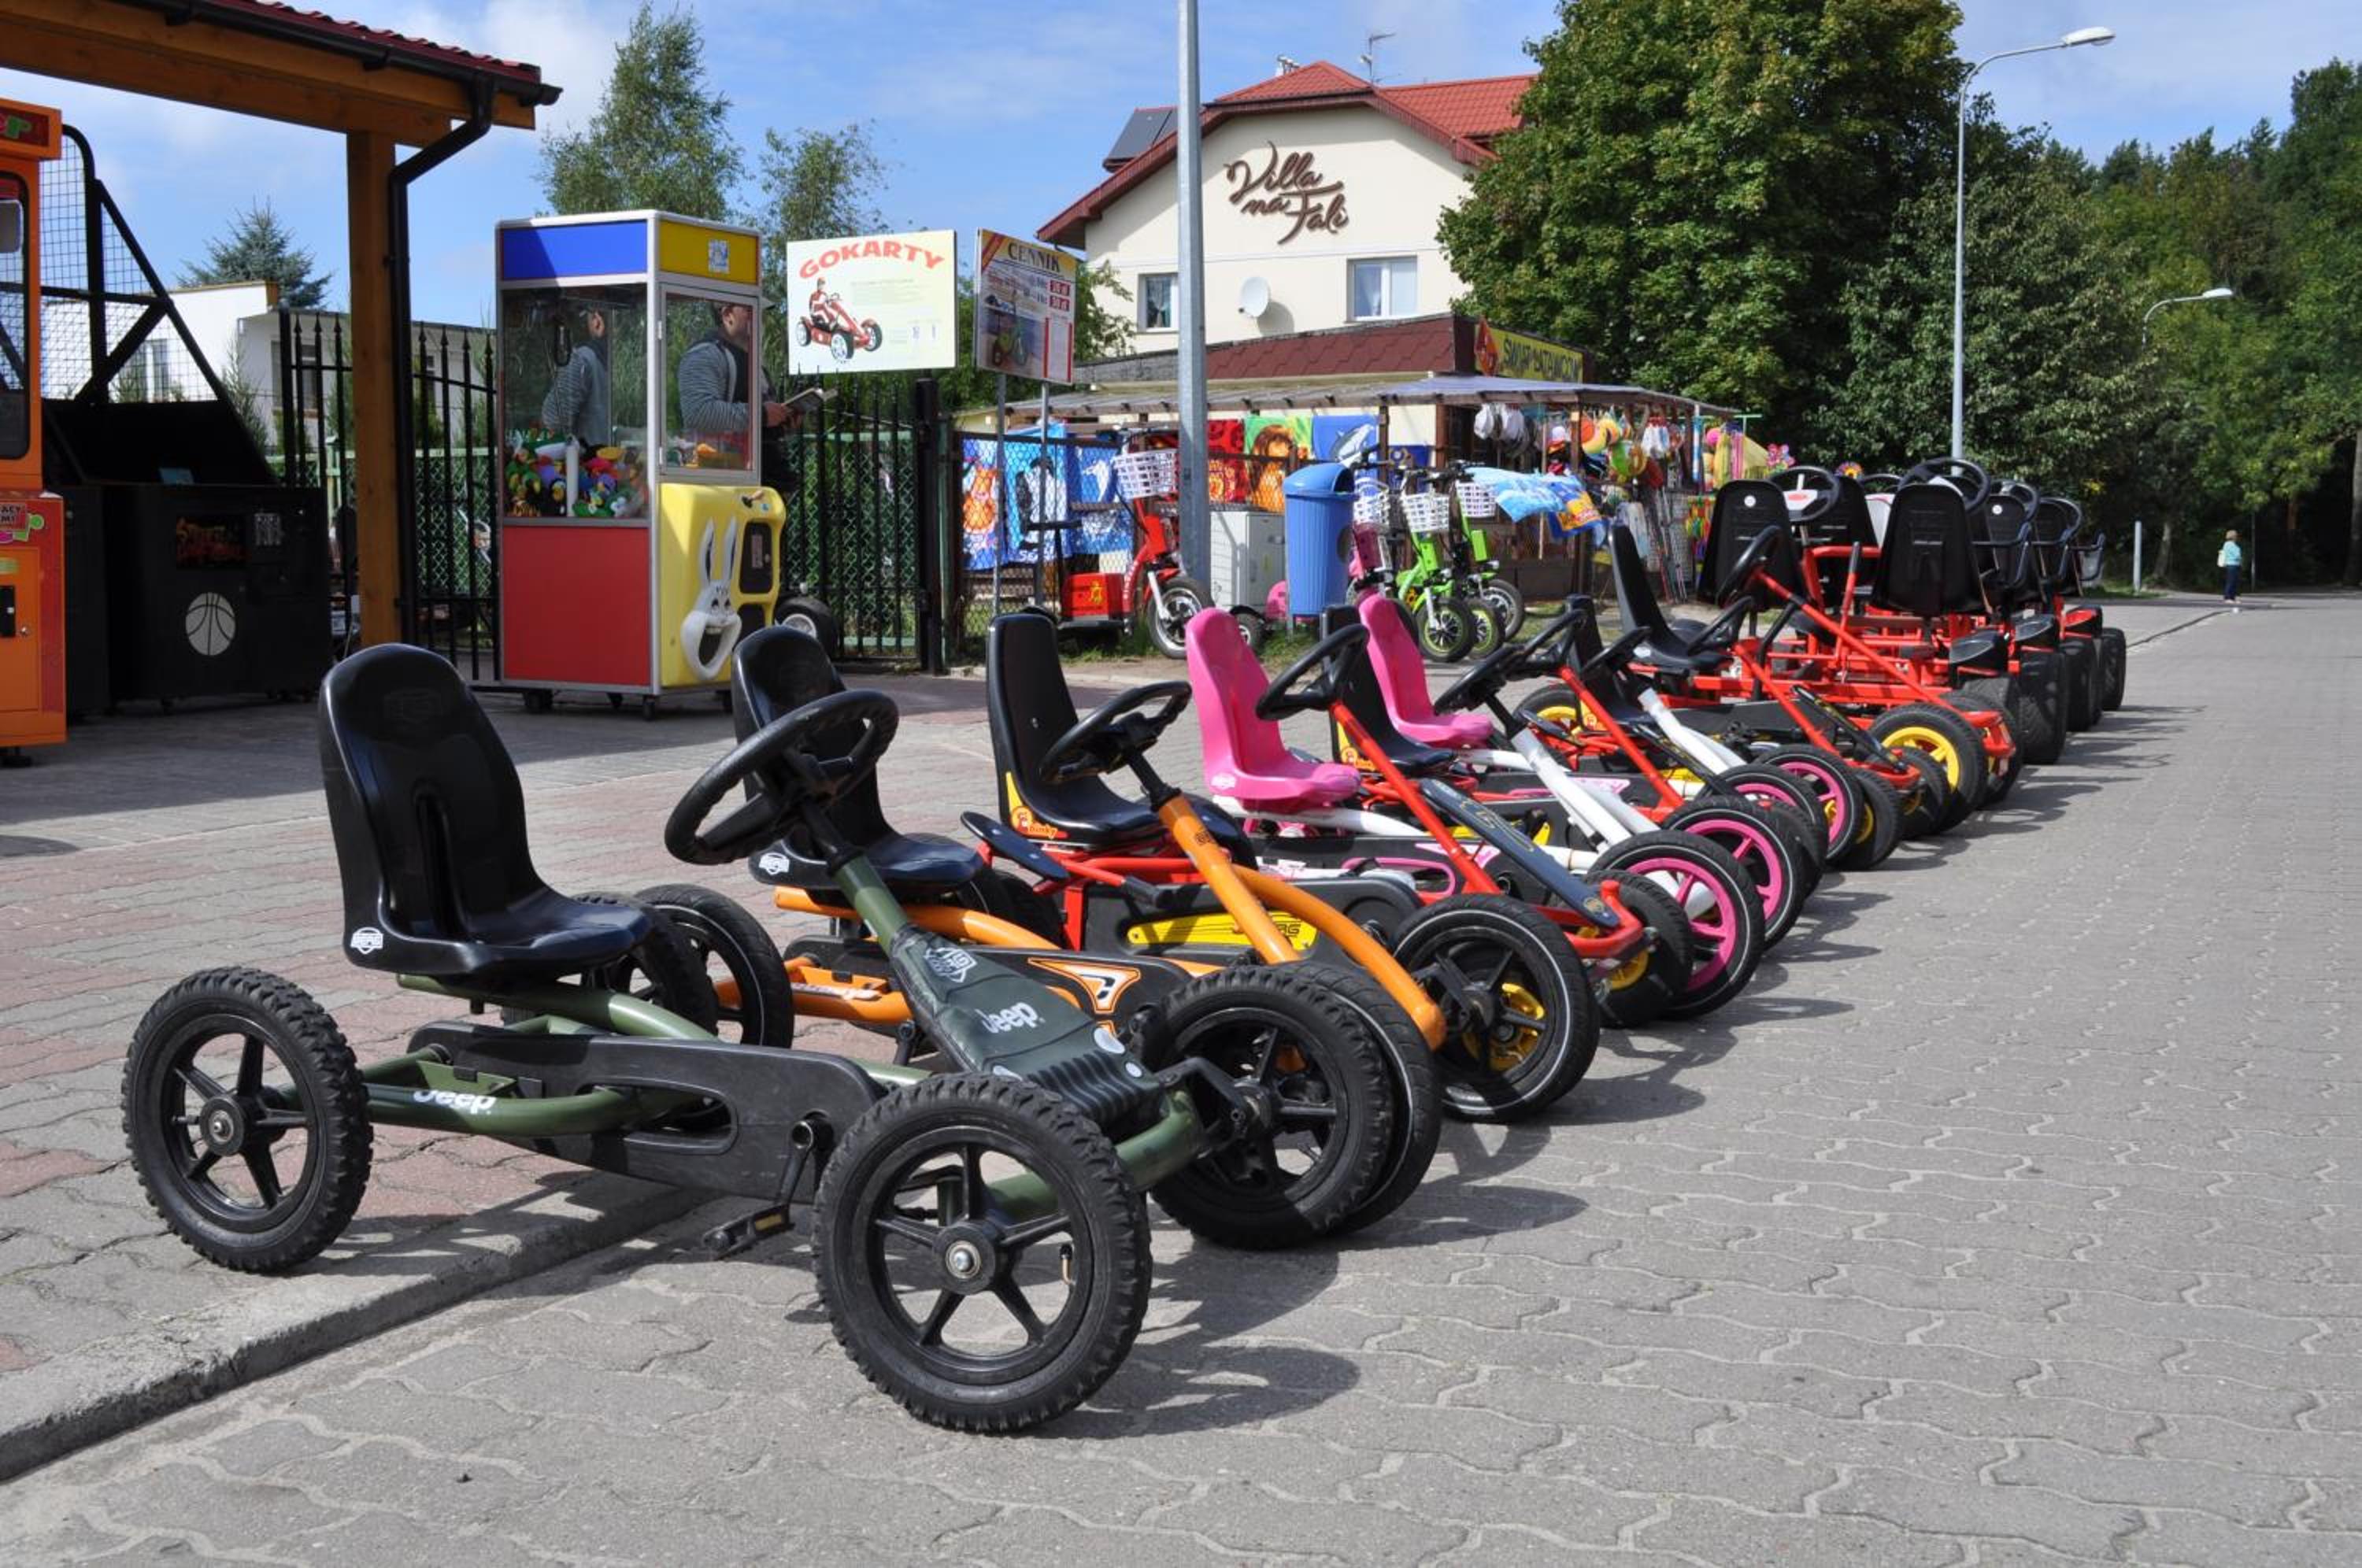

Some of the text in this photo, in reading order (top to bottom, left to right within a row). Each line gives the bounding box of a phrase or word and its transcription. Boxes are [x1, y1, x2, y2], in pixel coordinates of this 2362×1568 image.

[1223, 139, 1324, 204] Villa
[799, 240, 944, 279] GOKARTY
[1007, 241, 1061, 274] CENNIK
[413, 1089, 497, 1115] Jeep
